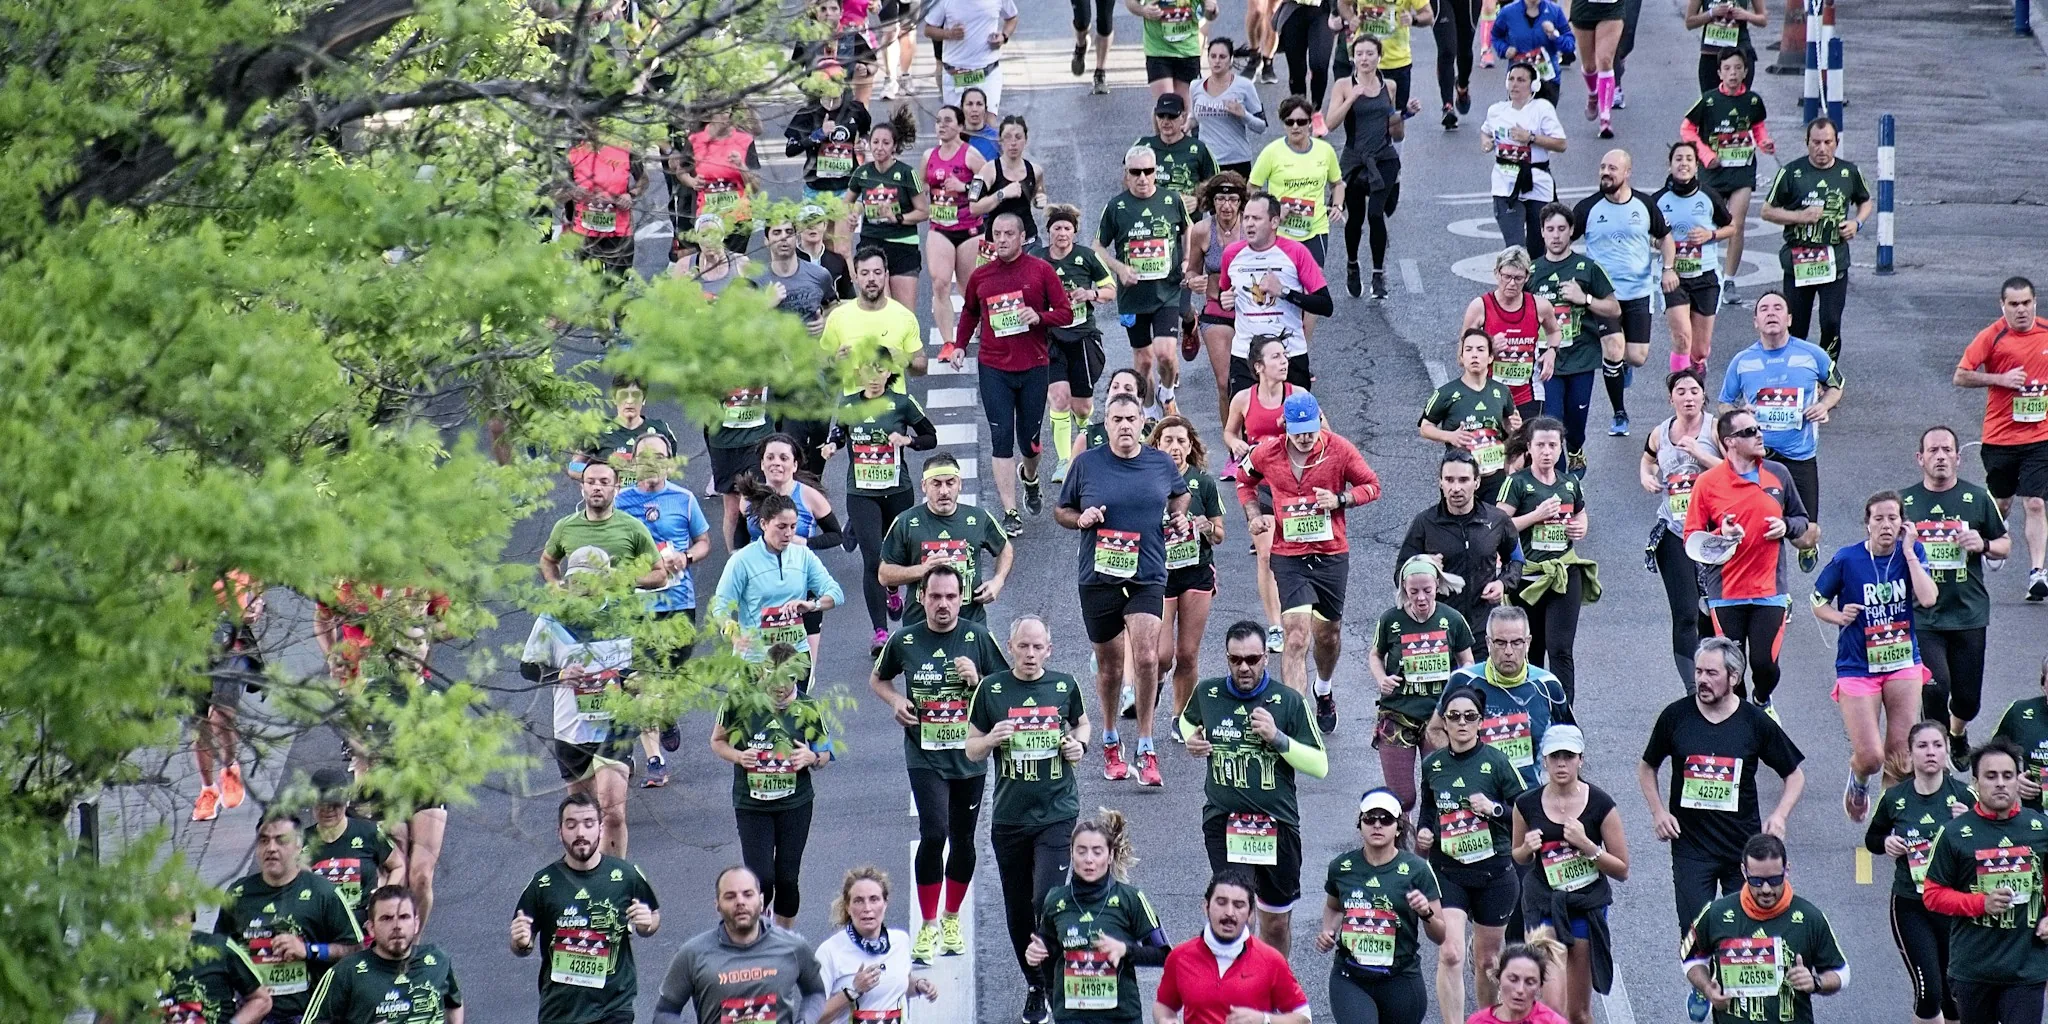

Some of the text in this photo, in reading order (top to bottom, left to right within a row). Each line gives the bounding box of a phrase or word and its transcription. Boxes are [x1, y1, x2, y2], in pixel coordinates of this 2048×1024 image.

[1128, 229, 1151, 237] MADRID
[1141, 261, 1159, 271] 40802
[2020, 401, 2044, 413] F43183
[1768, 410, 1788, 421] 26301
[862, 469, 888, 480] F41915
[1297, 520, 1319, 533] 43163
[1168, 548, 1190, 560] 40901
[1931, 548, 1954, 559] 42954
[1107, 556, 1129, 568] 42936
[1864, 601, 1906, 620] FOR THE
[770, 630, 798, 642] F41770
[1876, 648, 1904, 662] F41624
[921, 663, 934, 671] edp
[1412, 658, 1441, 671] F40676
[913, 673, 942, 681] MADRID
[1222, 718, 1233, 727] edp
[937, 729, 960, 740] 42804
[1212, 728, 1241, 739] MADRID
[1026, 736, 1050, 749] 41756
[1698, 786, 1724, 799] 42572
[1242, 841, 1266, 853] 41644
[1451, 840, 1483, 855] F40694
[1556, 862, 1588, 882] F40897
[563, 906, 578, 916] edp
[1343, 901, 1372, 909] MADRID
[556, 918, 588, 928] MADRID
[1351, 938, 1384, 953] F40834
[569, 959, 597, 975] 42859
[269, 969, 296, 982] 42384
[1738, 971, 1766, 985] 42659
[1073, 983, 1106, 997] F41987
[375, 1002, 410, 1014] MADRID
